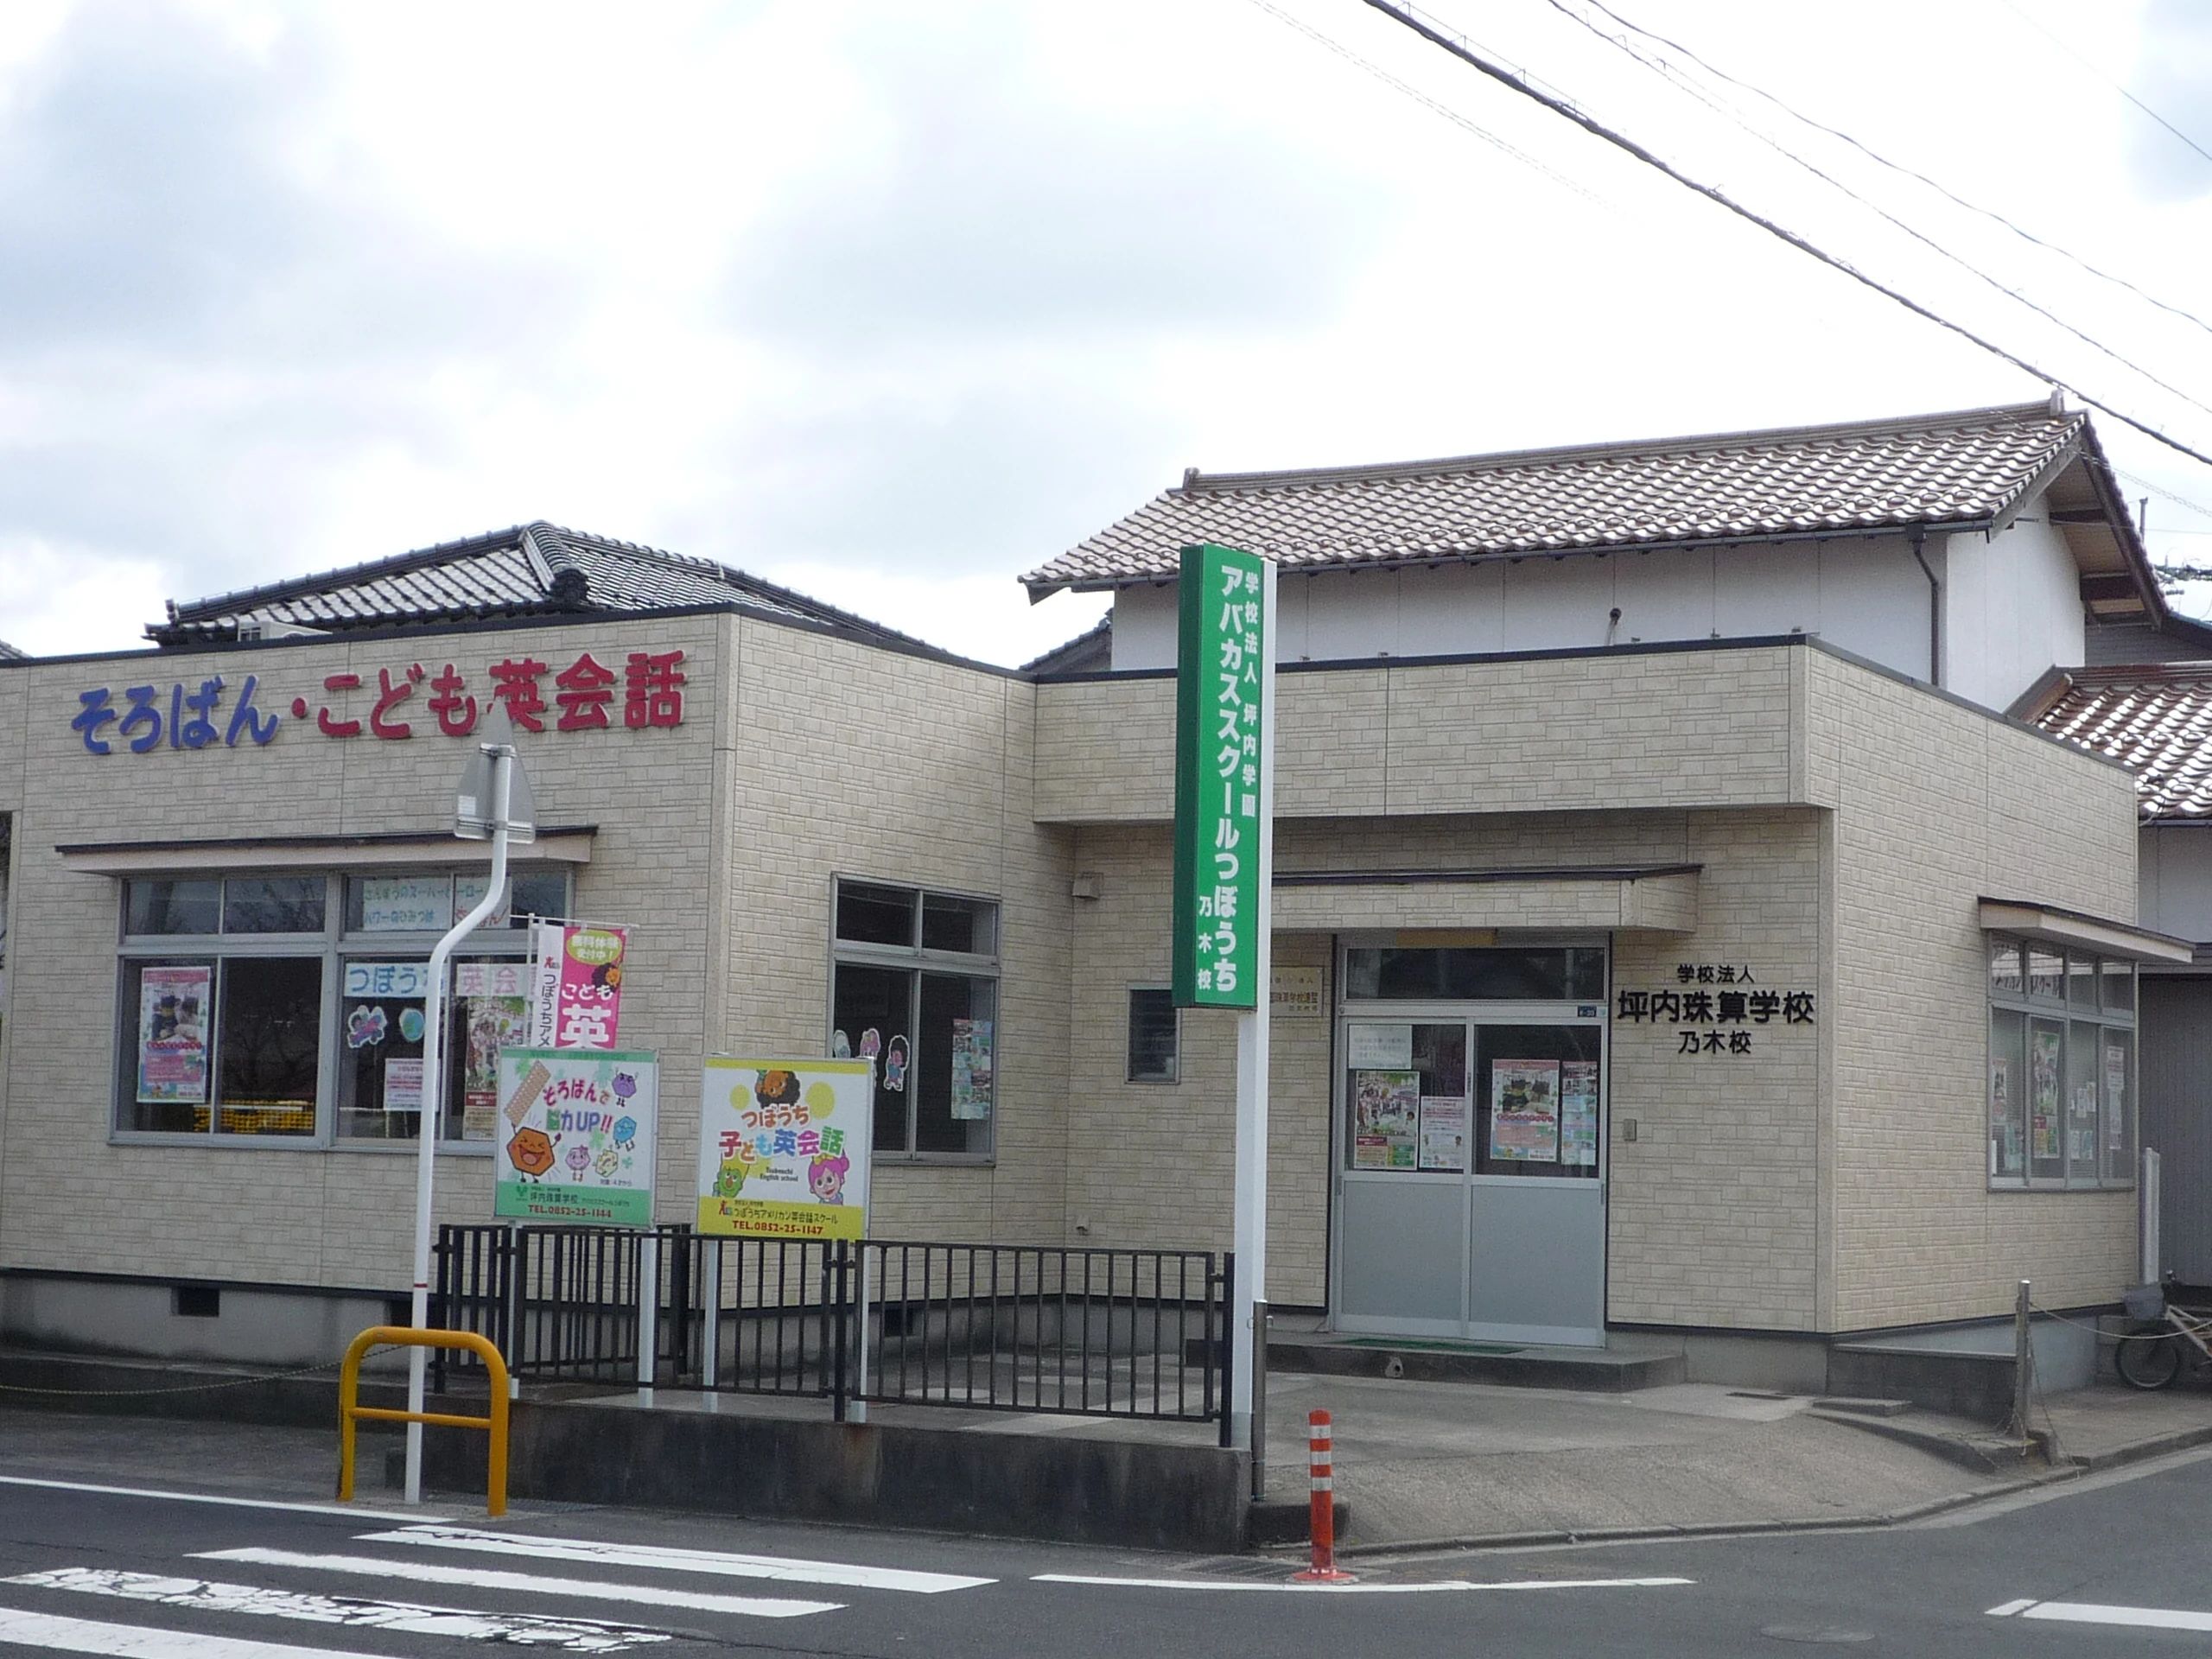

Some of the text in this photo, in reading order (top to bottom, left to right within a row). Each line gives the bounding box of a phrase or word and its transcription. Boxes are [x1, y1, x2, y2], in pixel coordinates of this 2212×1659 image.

[1243, 571, 1259, 684] 学校法人
[71, 650, 688, 754] そろばん・こども英会話
[1213, 565, 1243, 992] アバカススクールつぼうち
[1198, 896, 1212, 990] 乃木校
[462, 967, 537, 994] 英会
[1677, 963, 1755, 984] 学校法人
[562, 983, 614, 1001] こども
[1618, 990, 1814, 1024] 坪内珠算学校
[558, 1003, 613, 1048] 英
[1678, 1029, 1751, 1054] 乃木校
[741, 1104, 809, 1128] つぼうち
[719, 1126, 844, 1162] 子ども英会話
